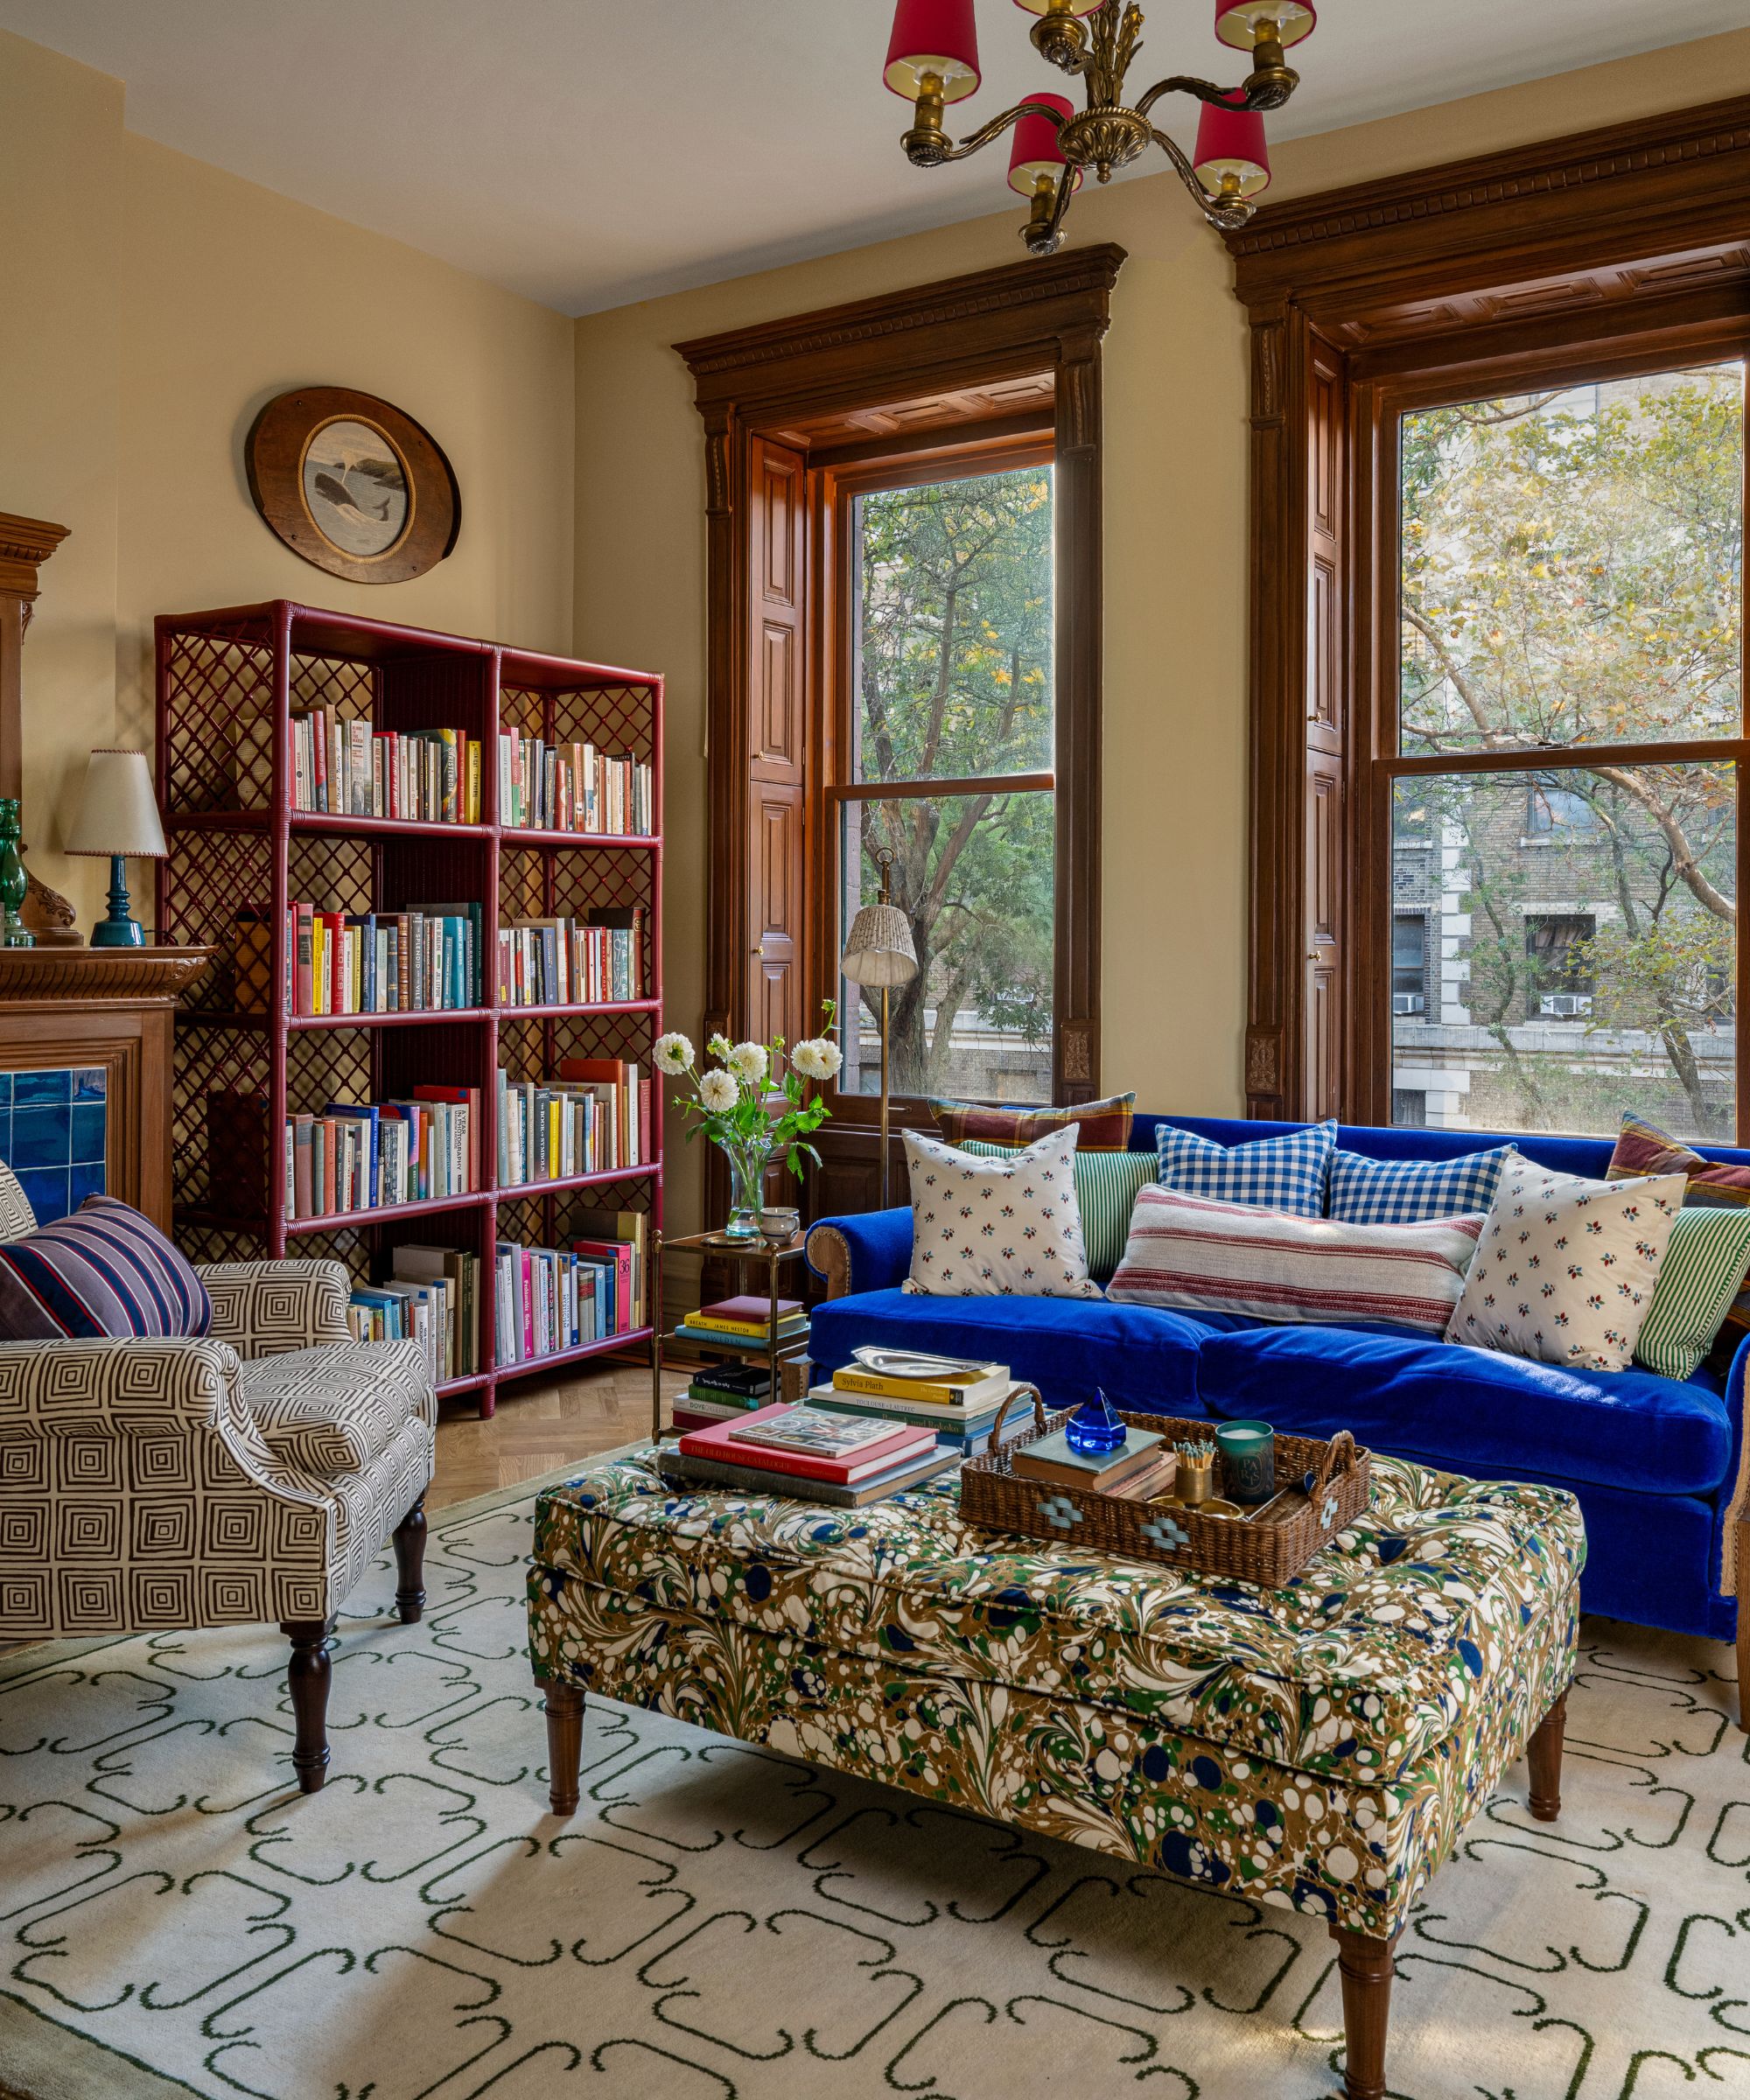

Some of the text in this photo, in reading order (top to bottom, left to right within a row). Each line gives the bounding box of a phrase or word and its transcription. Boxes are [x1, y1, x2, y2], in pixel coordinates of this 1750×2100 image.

[620, 1259, 630, 1275] 36
[706, 1334, 742, 1346] SWEDEN
[842, 1377, 885, 1391] Sylvia Plath
[928, 1421, 960, 1434] Rokoko
[690, 1444, 791, 1471] THE OLD HOUSE CATALOGUE
